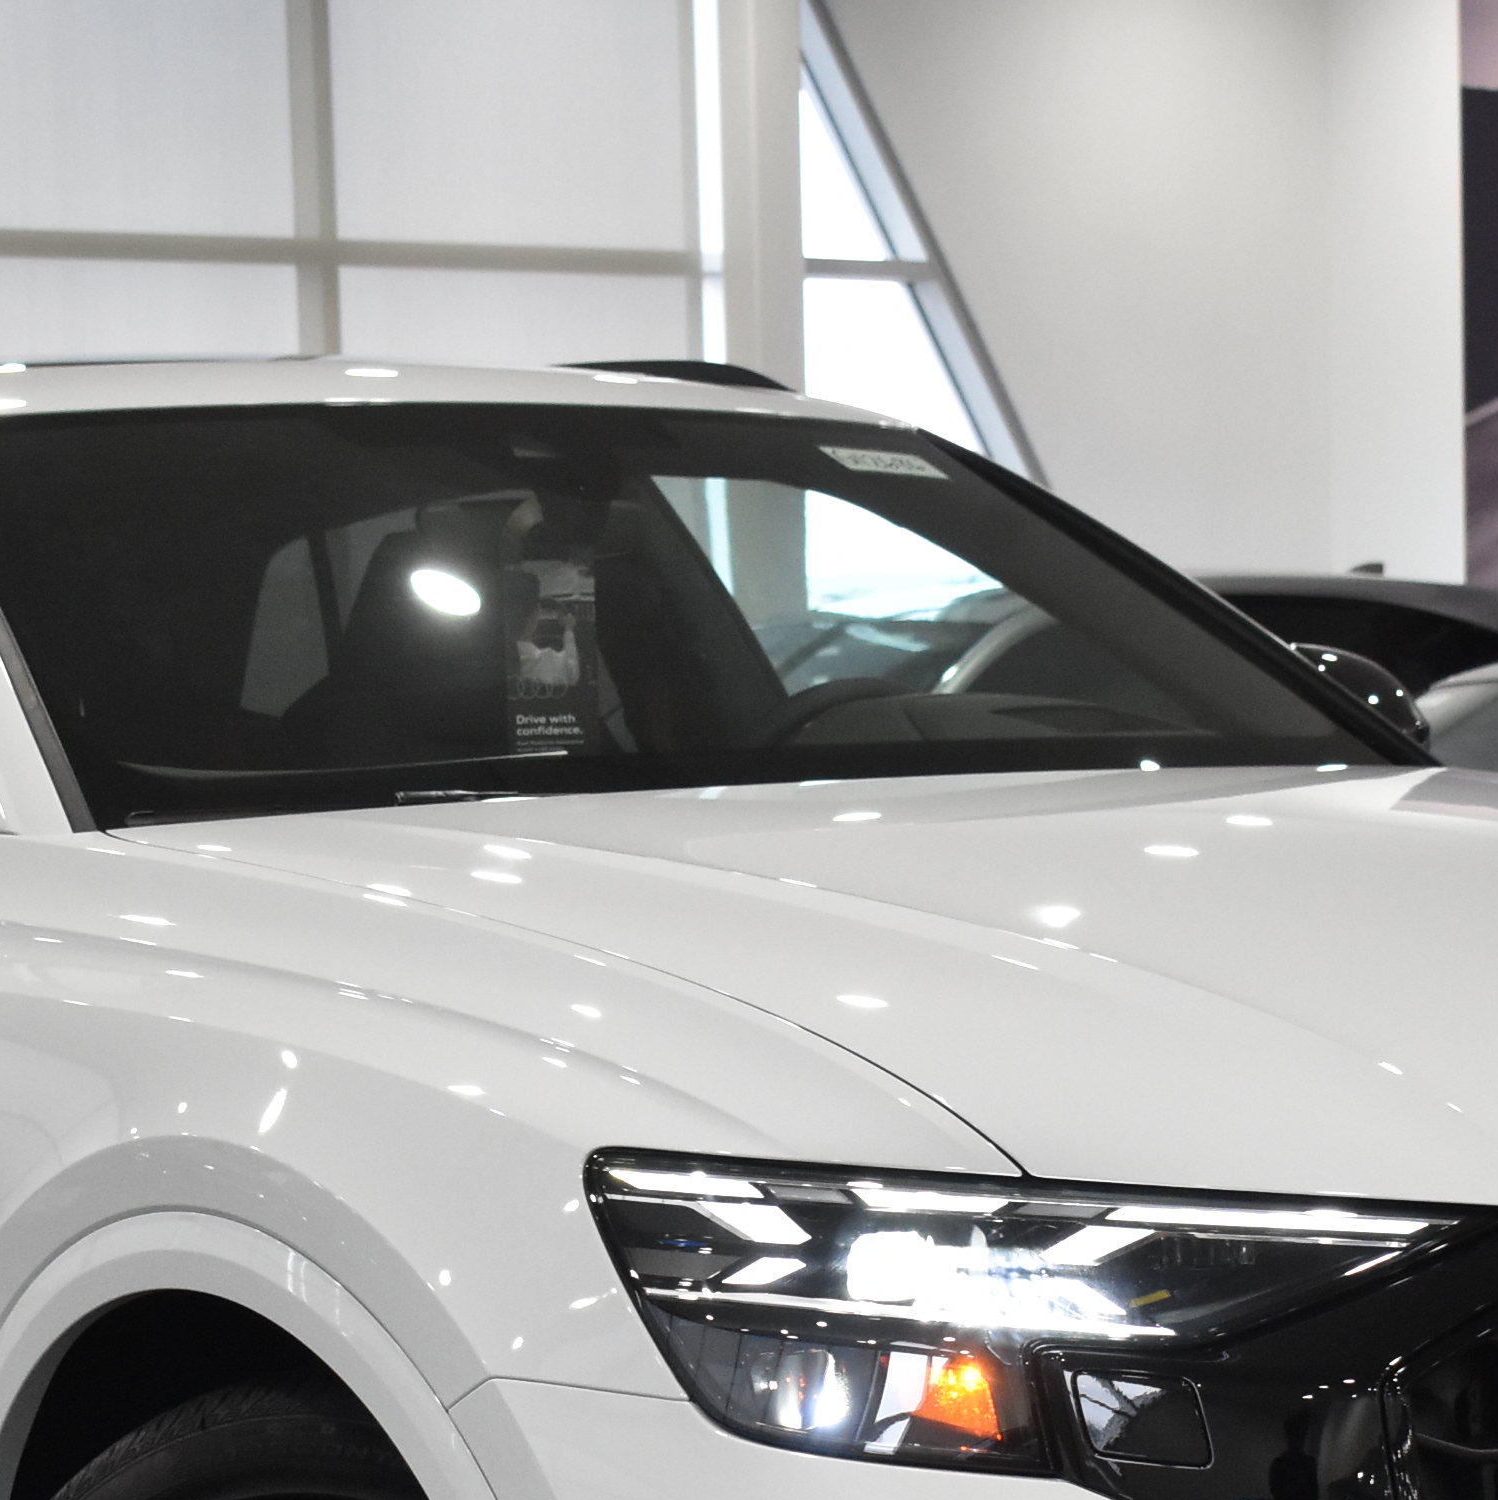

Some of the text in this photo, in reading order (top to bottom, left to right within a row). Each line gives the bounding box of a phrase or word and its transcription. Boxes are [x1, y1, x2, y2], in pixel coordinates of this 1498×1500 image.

[516, 713, 576, 725] Drive with
[516, 726, 584, 736] confidence.
